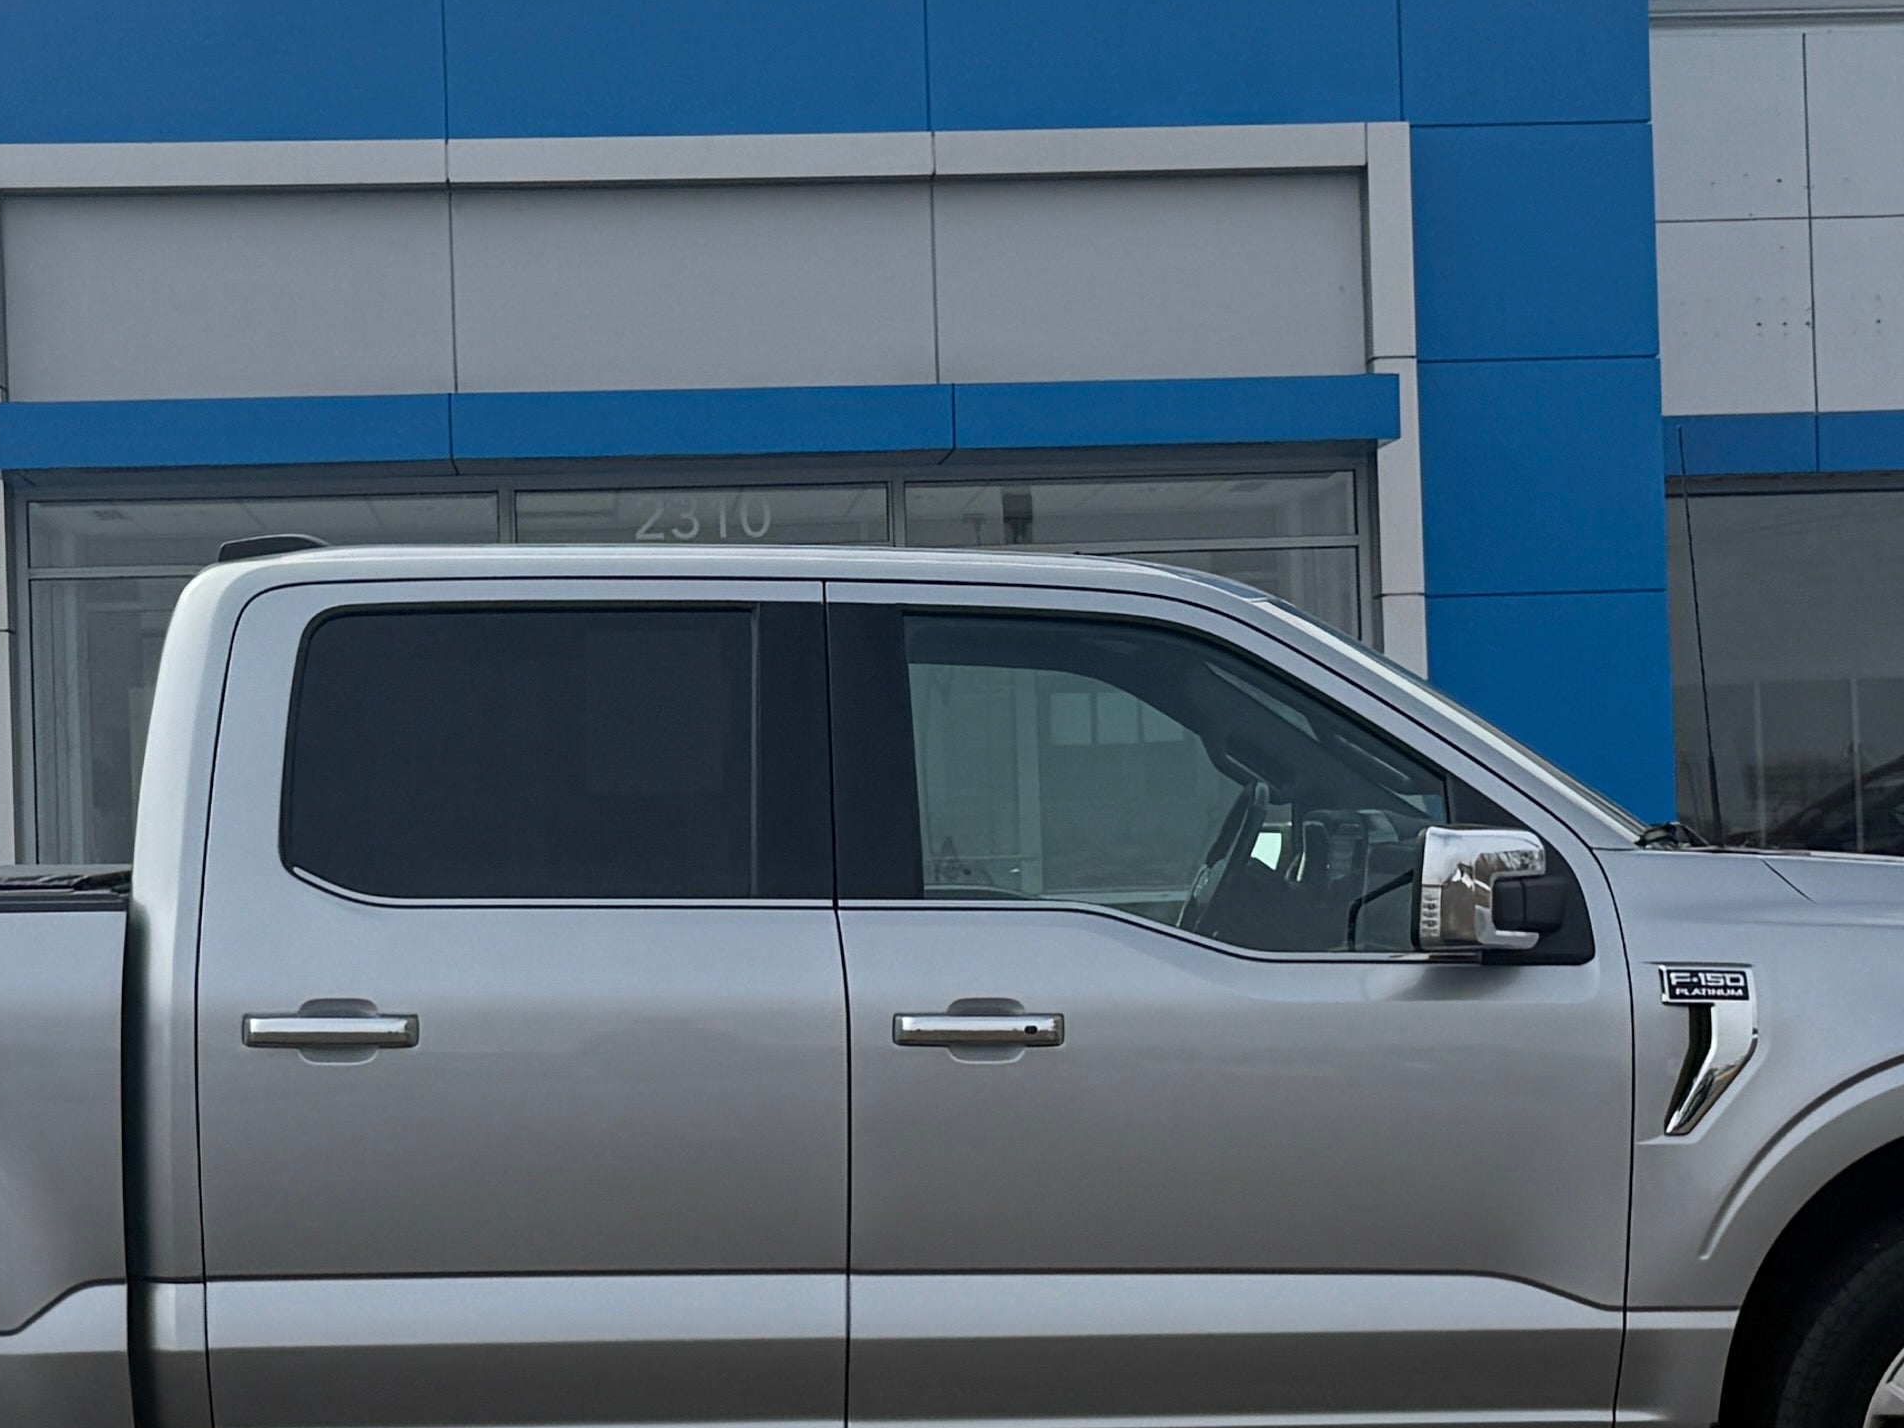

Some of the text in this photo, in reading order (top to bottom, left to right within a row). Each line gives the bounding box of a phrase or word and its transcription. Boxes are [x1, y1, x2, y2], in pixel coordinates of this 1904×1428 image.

[635, 493, 772, 541] 2310
[1669, 972, 1745, 987] F-150
[1676, 987, 1744, 997] PLATINUM
